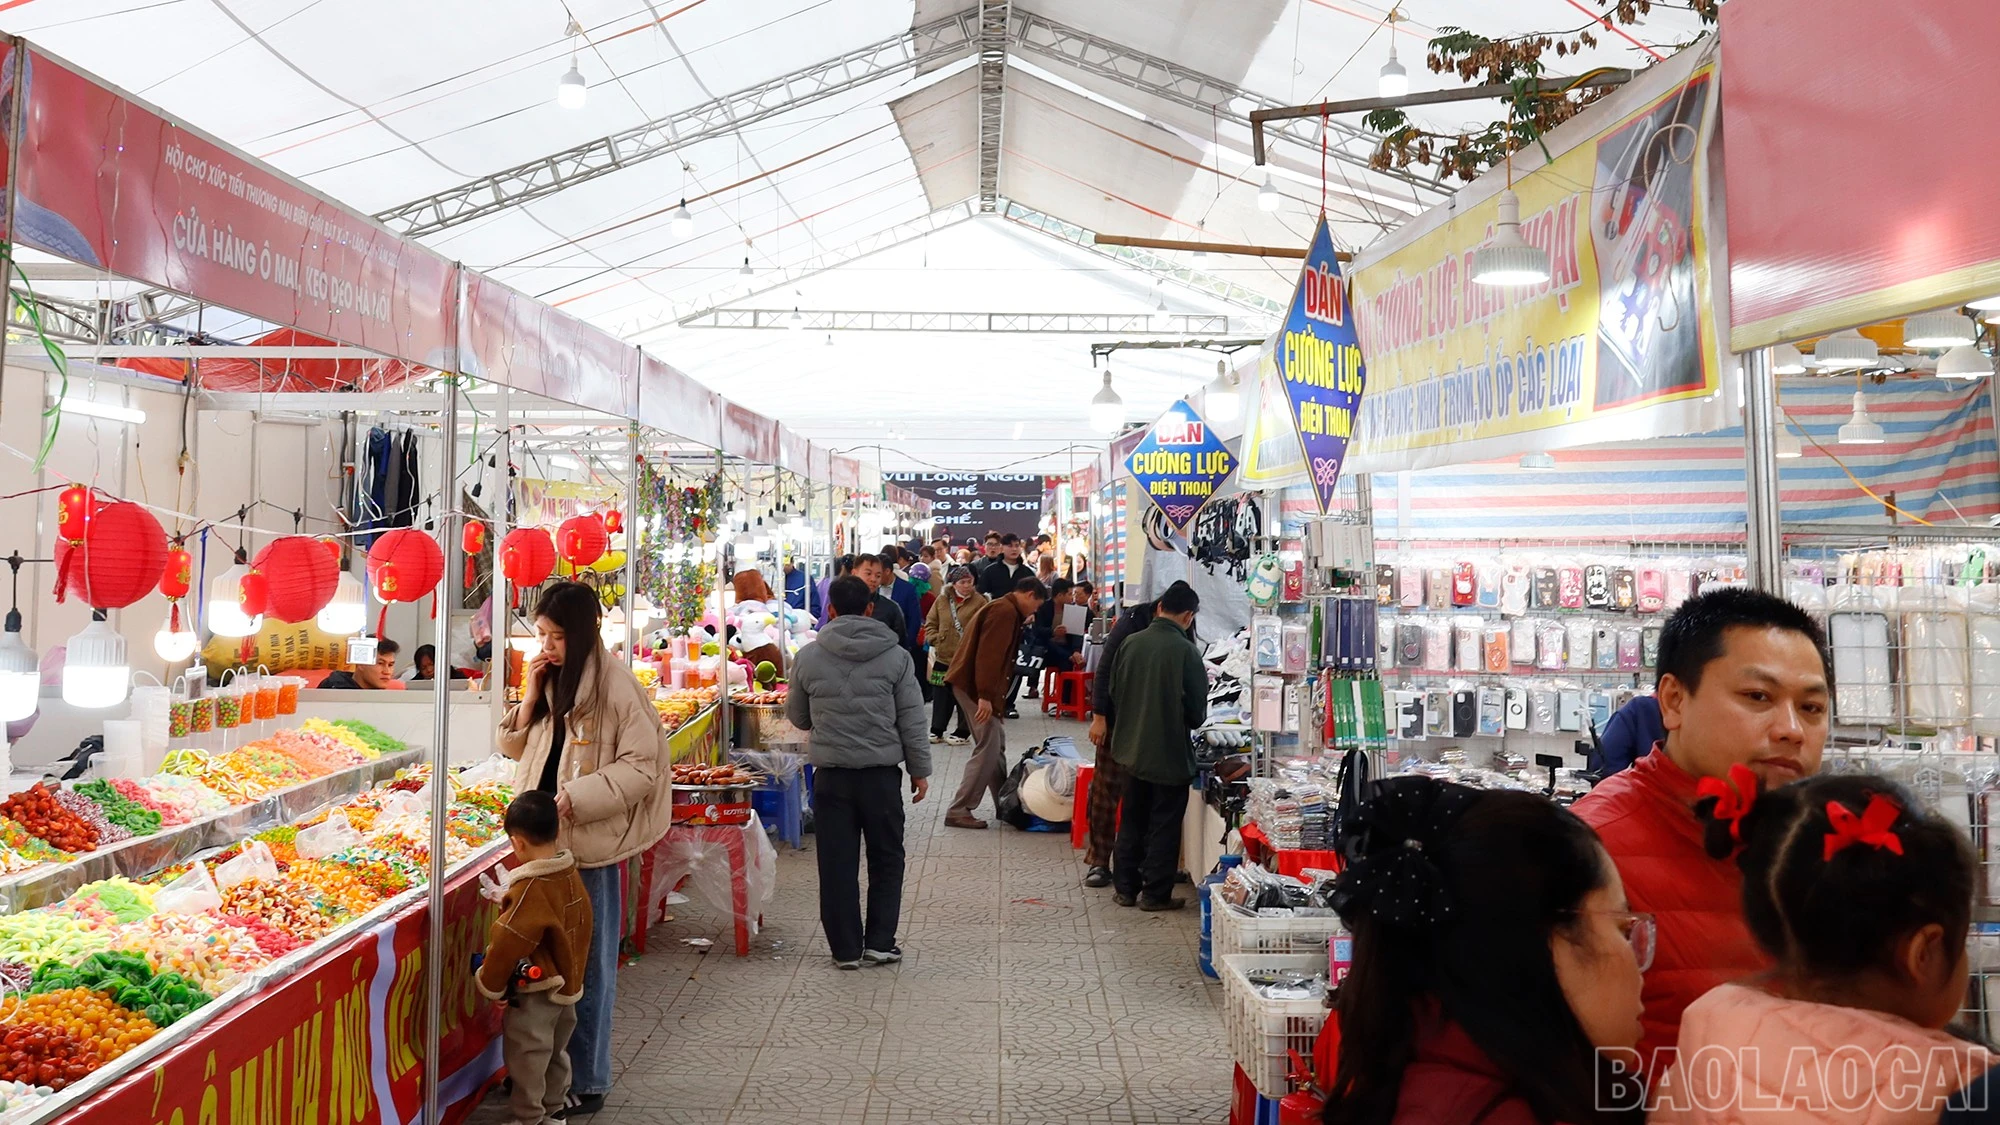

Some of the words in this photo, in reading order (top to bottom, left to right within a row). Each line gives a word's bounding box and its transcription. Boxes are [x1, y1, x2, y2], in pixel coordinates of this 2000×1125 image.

[165, 144, 184, 173] HỘI
[185, 154, 208, 185] CHỢ
[207, 163, 227, 190] XÚC
[228, 172, 246, 198] TIẾN
[173, 206, 208, 259] CỬA
[213, 224, 257, 275] HÀNG
[260, 240, 271, 280] Ô
[305, 265, 328, 306] KẸO
[355, 281, 370, 316] HÀ
[1306, 262, 1342, 323] DÁN
[1428, 254, 1458, 350] LỰC
[1284, 323, 1335, 390] CƯỜNG
[1337, 343, 1362, 404] LỰC
[1496, 342, 1513, 417] ỐP
[1517, 342, 1546, 413] CÁC
[1549, 341, 1584, 417] LOẠI
[1300, 395, 1324, 441] ĐIỆN
[1324, 404, 1351, 445] THOẠI
[936, 484, 979, 496] GHẾ
[1132, 447, 1192, 475] CƯỜNG
[1196, 449, 1230, 480] LỰC
[1150, 478, 1177, 499] ĐIỆN
[1179, 481, 1212, 499] THOẠI
[958, 500, 985, 510] XÊ
[990, 501, 1039, 512] DỊCH
